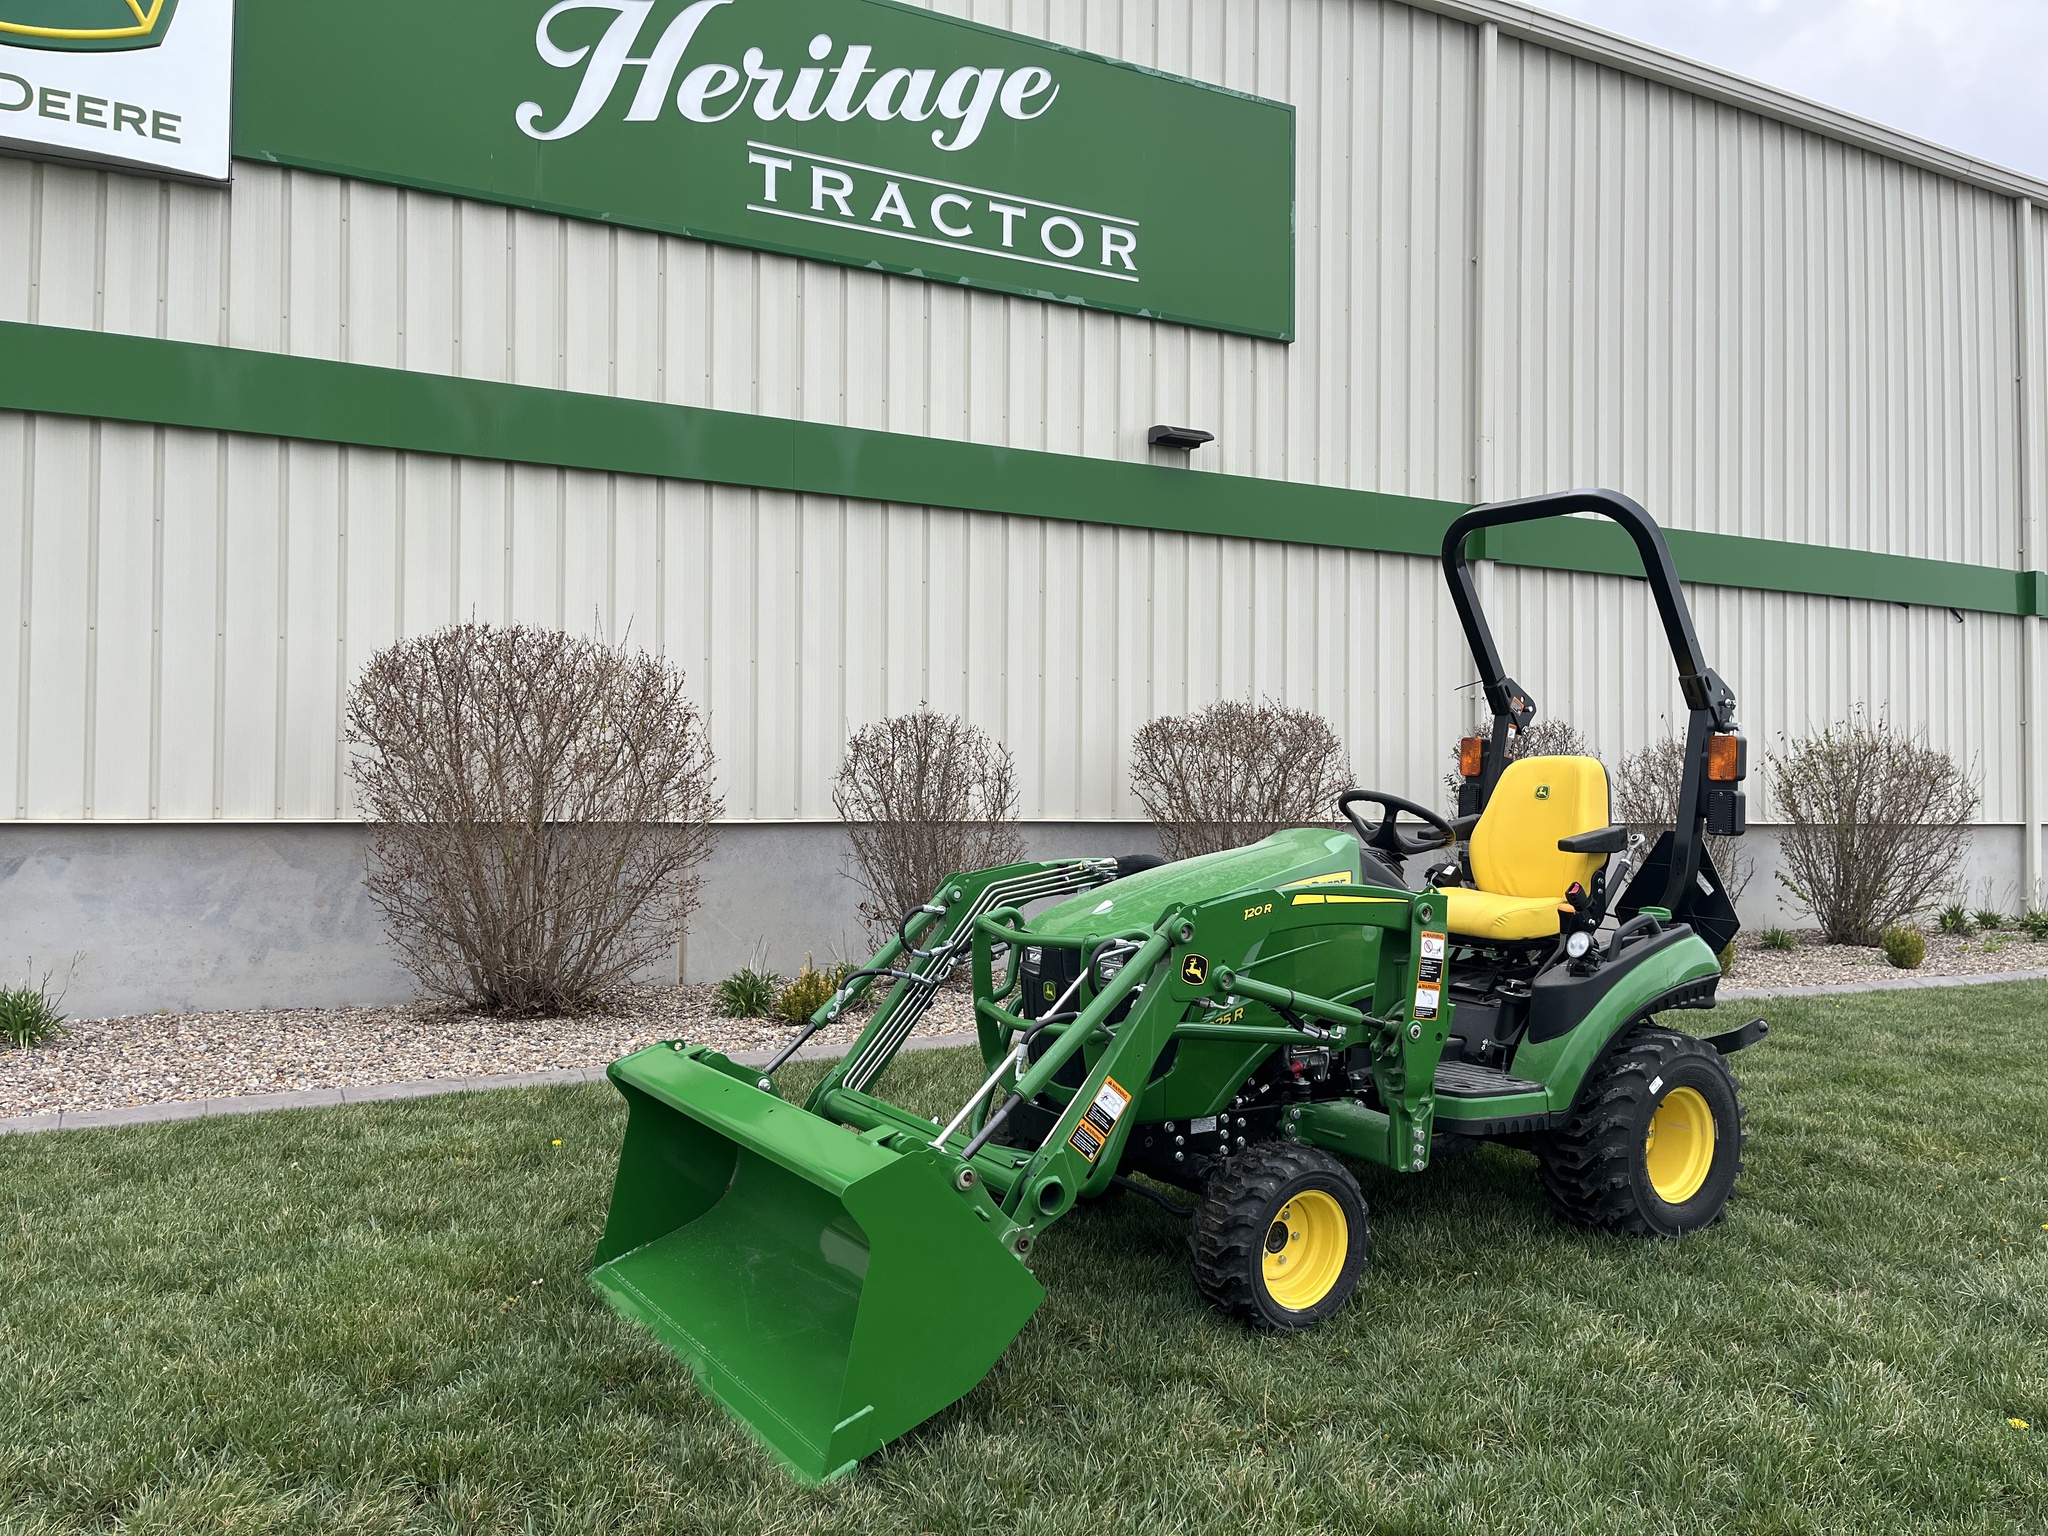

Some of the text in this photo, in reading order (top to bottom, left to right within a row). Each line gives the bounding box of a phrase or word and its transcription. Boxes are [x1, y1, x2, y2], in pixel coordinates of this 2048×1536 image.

[0, 72, 182, 145] DEERE
[514, 0, 1060, 152] Heritage
[747, 151, 1138, 271] TRACTOR
[1244, 903, 1273, 921] 120 R
[1233, 1007, 1244, 1022] R
